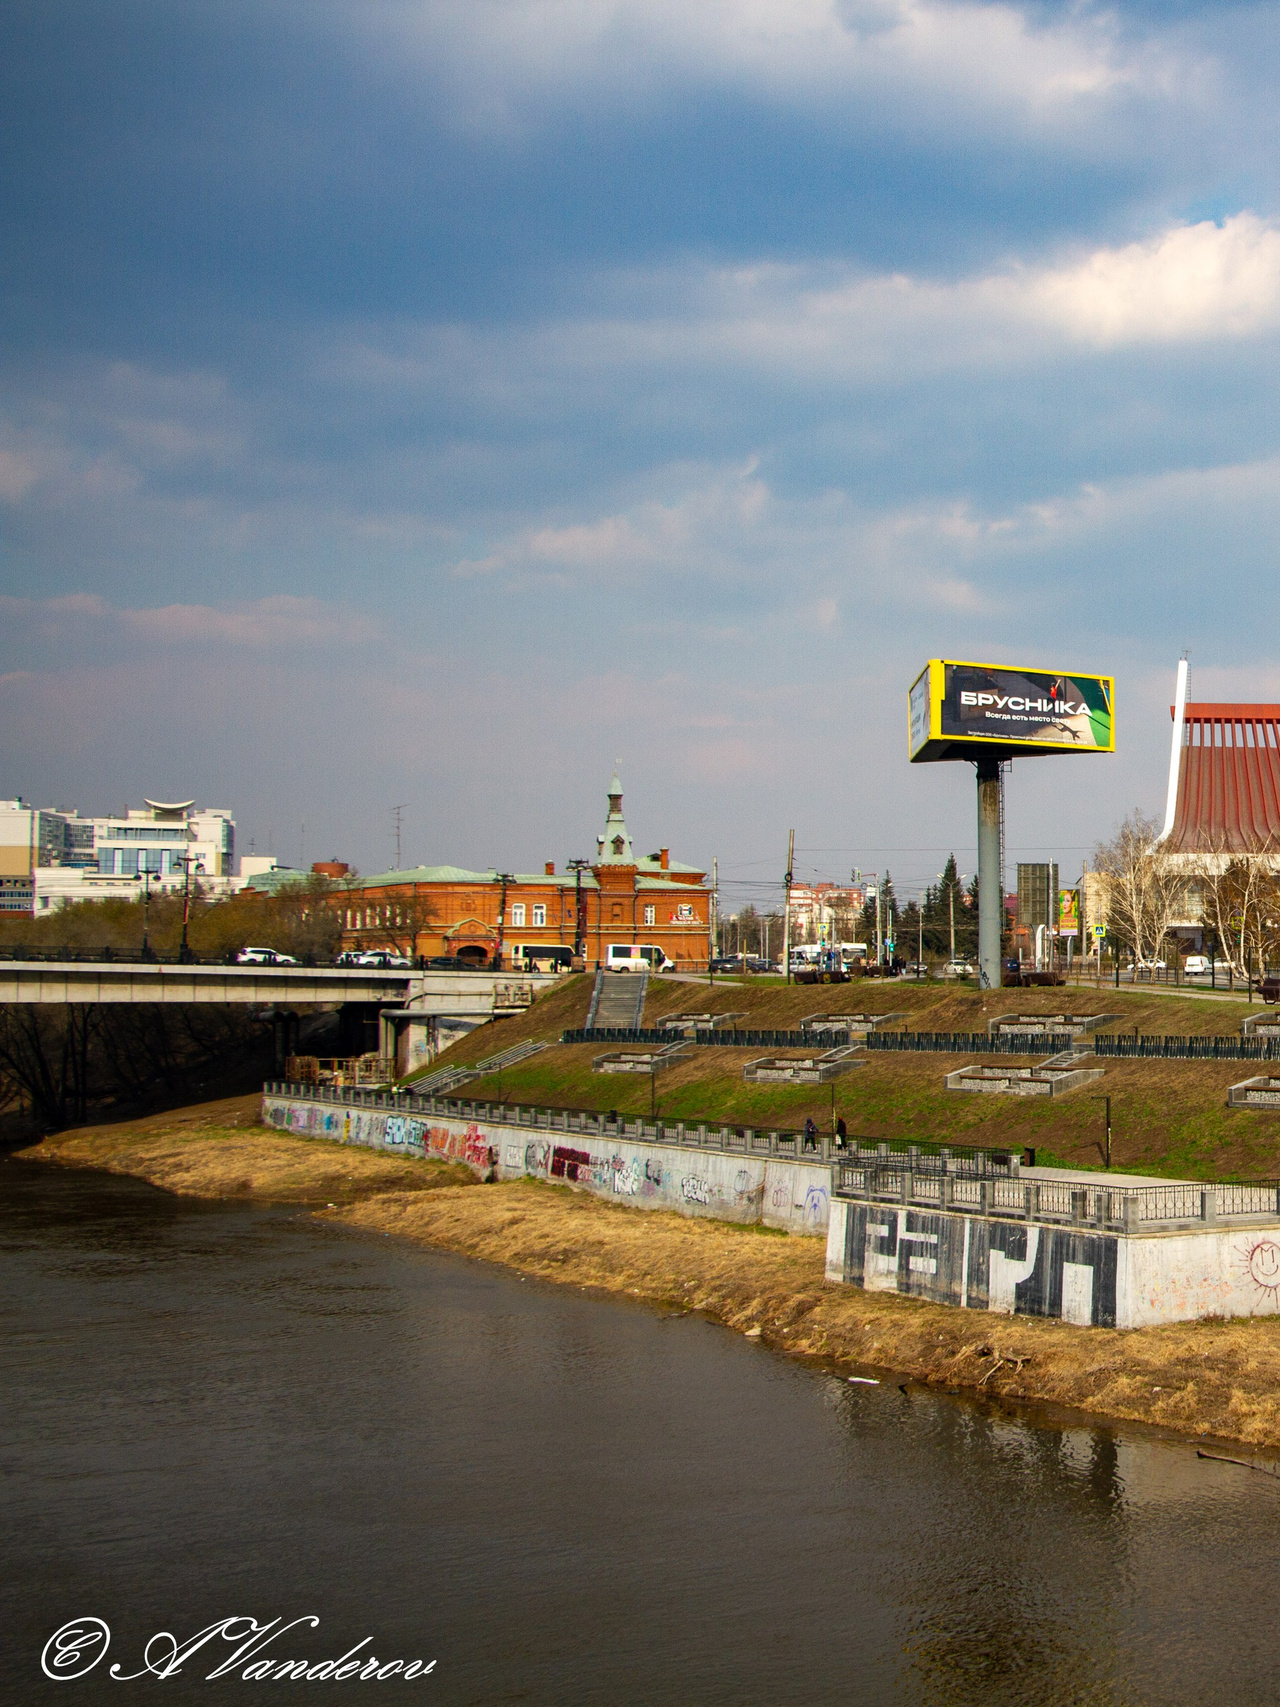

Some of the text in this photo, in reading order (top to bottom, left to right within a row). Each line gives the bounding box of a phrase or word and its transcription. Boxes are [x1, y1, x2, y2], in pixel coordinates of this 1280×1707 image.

[961, 691, 1093, 716] БРУСНИКА
[985, 711, 1011, 720] Всегда
[1012, 714, 1028, 722] есть
